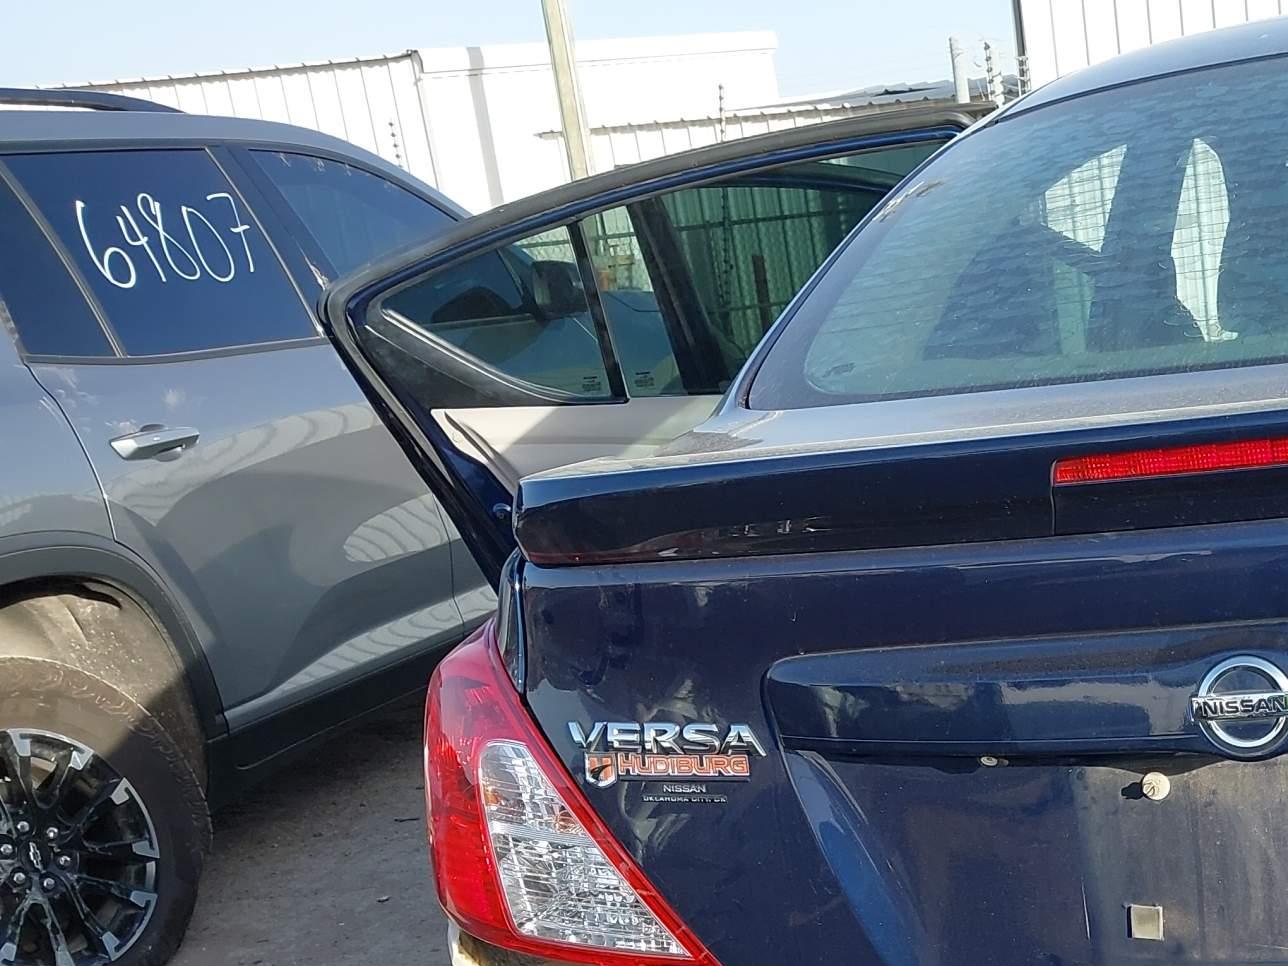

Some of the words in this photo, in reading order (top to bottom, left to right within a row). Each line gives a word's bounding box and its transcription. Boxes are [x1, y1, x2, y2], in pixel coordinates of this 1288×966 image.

[75, 192, 254, 289] 64807
[1201, 697, 1287, 716] NISSAN
[567, 721, 767, 757] VERSA
[618, 752, 750, 777] HUDIBURG
[663, 784, 706, 793] NISSAN
